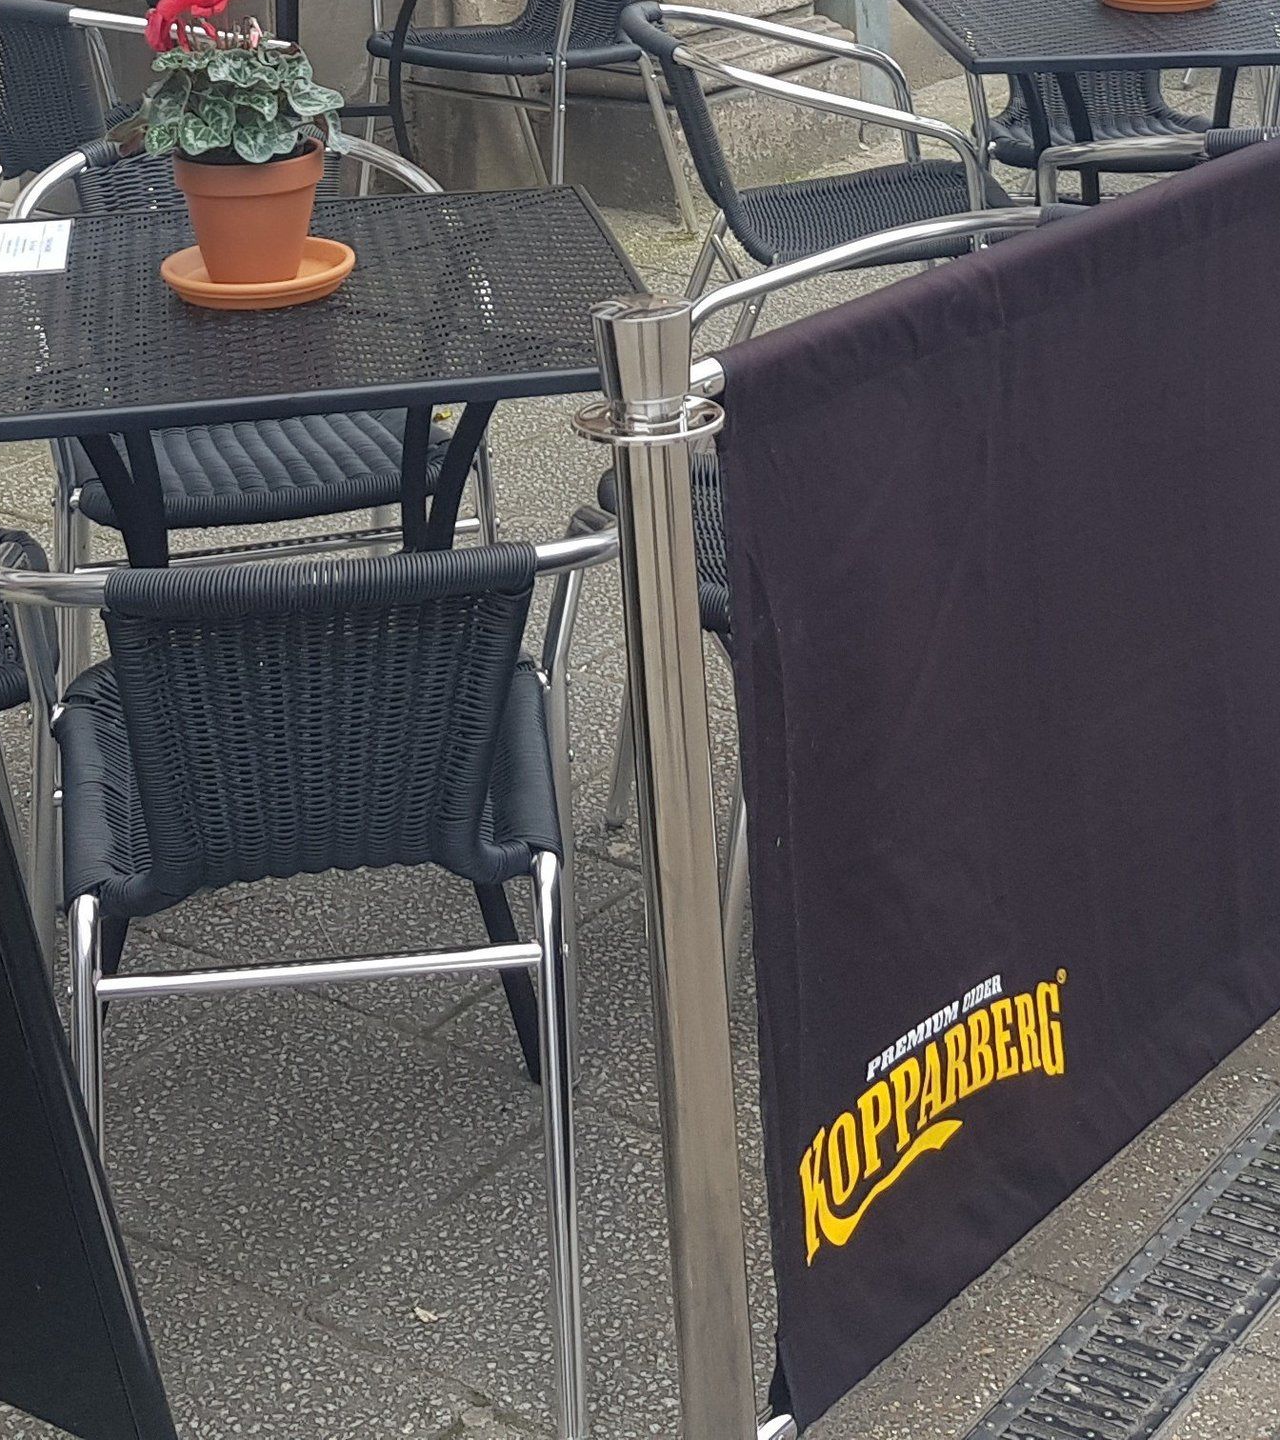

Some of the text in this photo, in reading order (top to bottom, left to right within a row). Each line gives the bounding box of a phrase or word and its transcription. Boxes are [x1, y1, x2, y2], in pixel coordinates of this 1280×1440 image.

[799, 981, 1066, 1268] KOPPARBERG
[865, 973, 1003, 1082] PREMIUM CIDER
